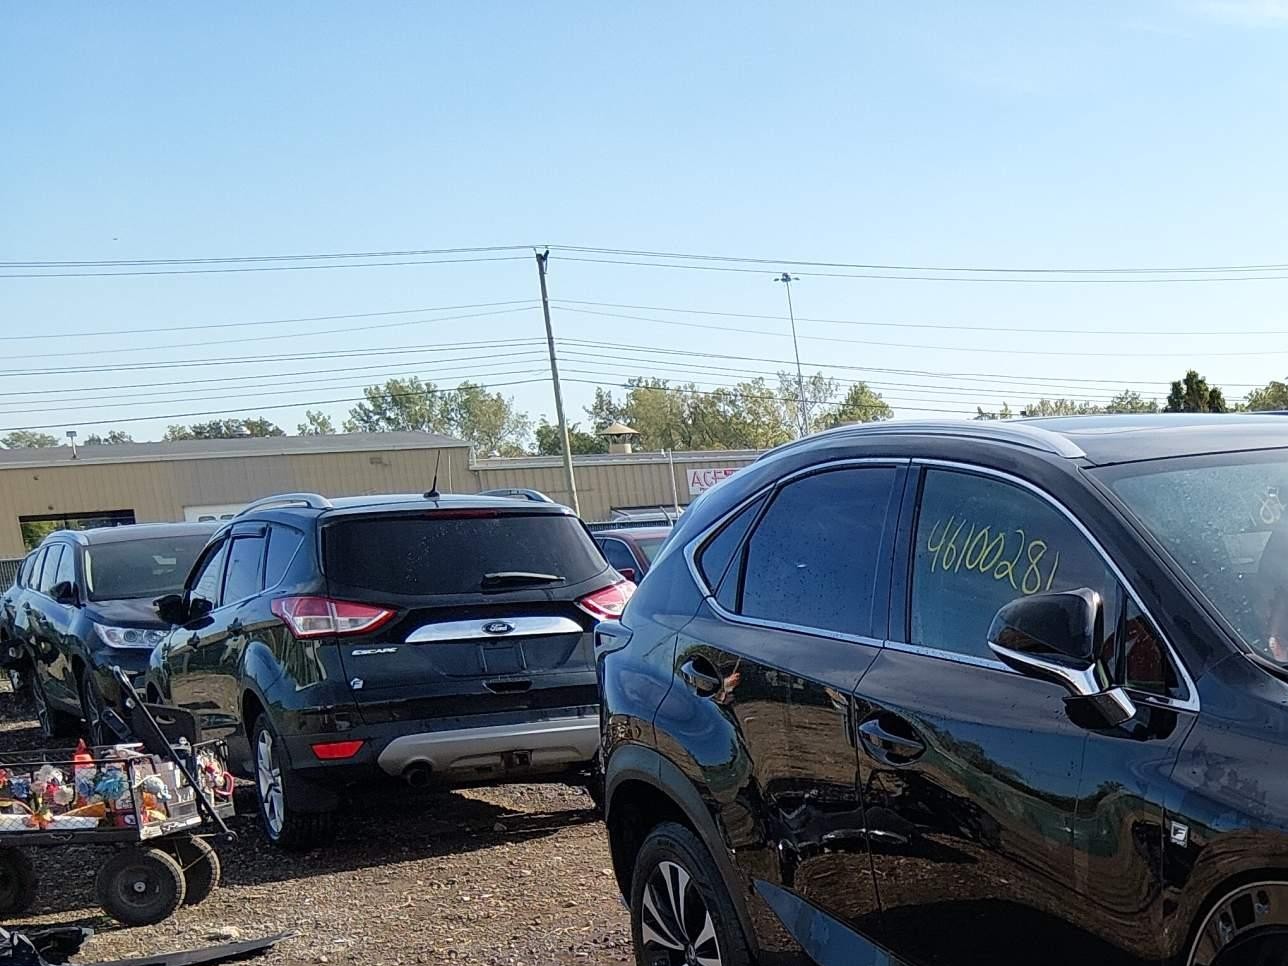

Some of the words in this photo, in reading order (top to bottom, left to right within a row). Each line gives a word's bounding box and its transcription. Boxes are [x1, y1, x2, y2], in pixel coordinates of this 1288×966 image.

[928, 514, 1060, 594] 46100281
[489, 623, 508, 632] Ford
[352, 647, 398, 656] ESCAPE
